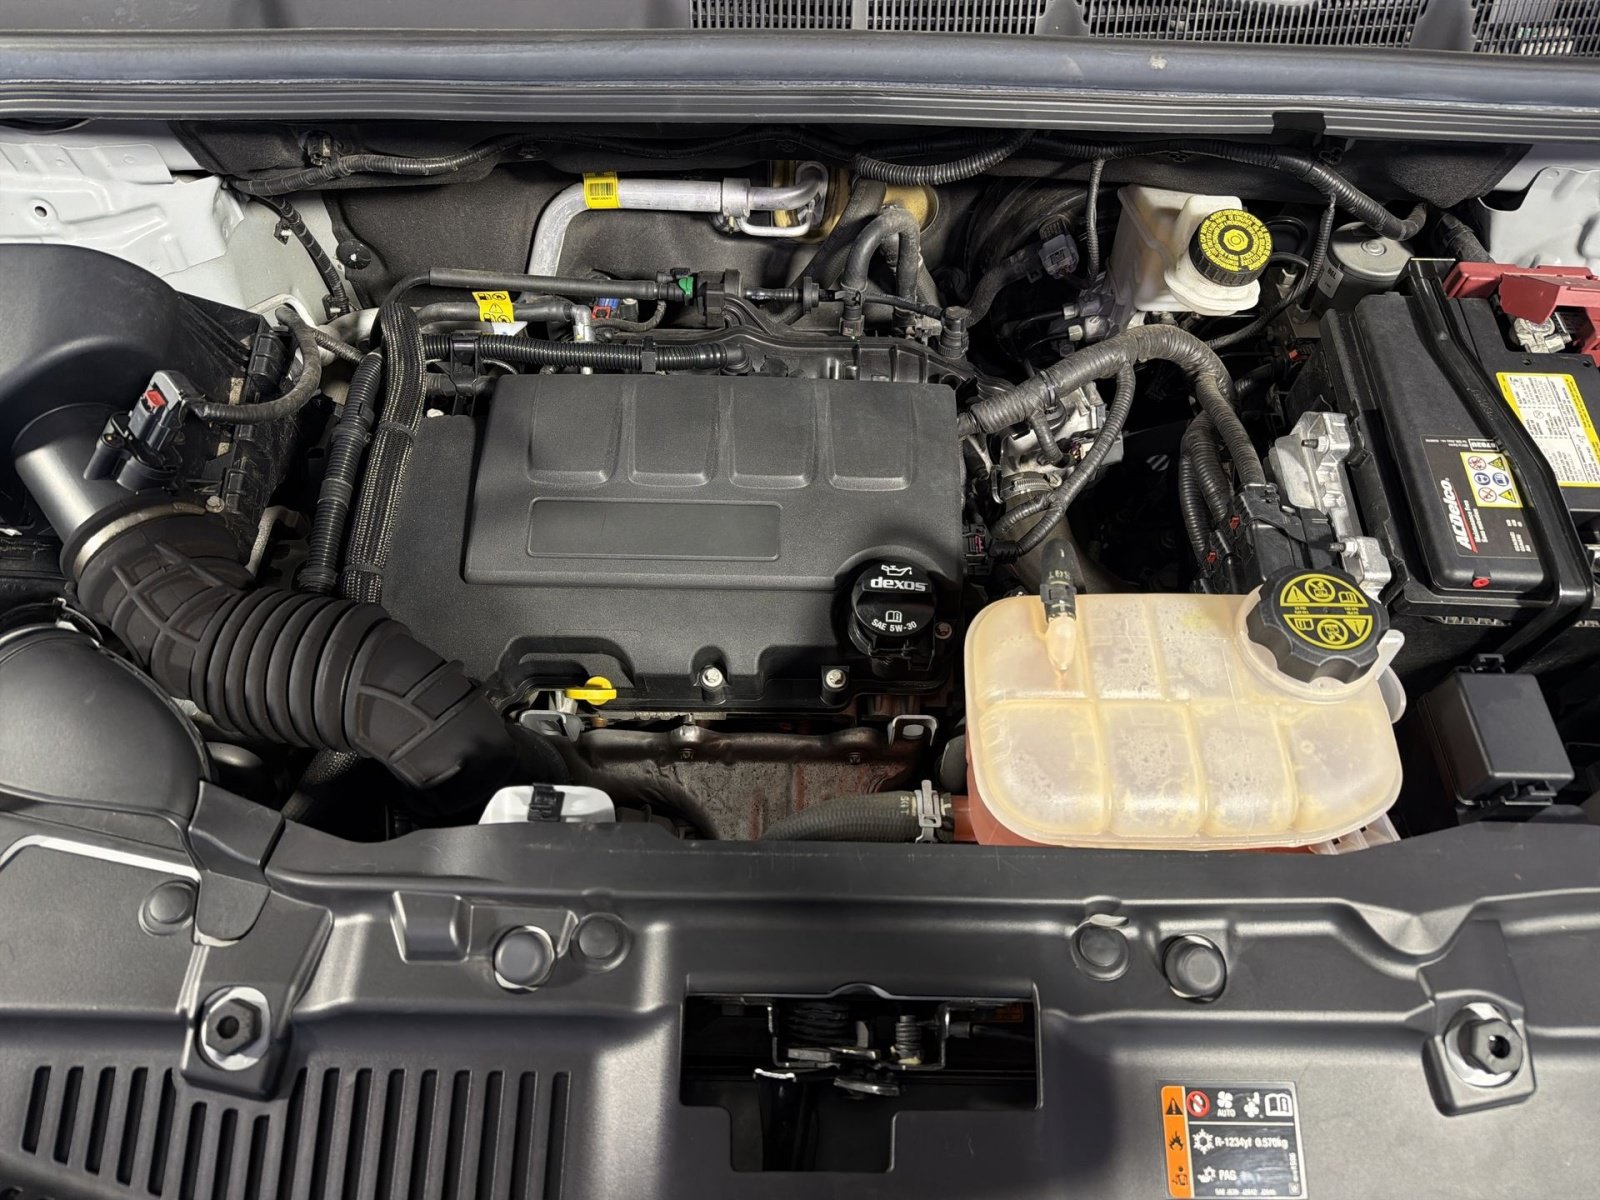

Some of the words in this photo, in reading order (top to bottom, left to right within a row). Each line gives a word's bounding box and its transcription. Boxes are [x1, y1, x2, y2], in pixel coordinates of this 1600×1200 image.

[1440, 479, 1473, 551] ACDelco
[870, 576, 928, 592] dexos
[871, 618, 887, 631] SAE
[889, 620, 918, 632] 5W-30
[1217, 1109, 1236, 1118] AUTO
[1214, 1137, 1252, 1150] R-1234yf
[1254, 1136, 1289, 1150] 0.570kg
[1218, 1169, 1237, 1181] PAG
